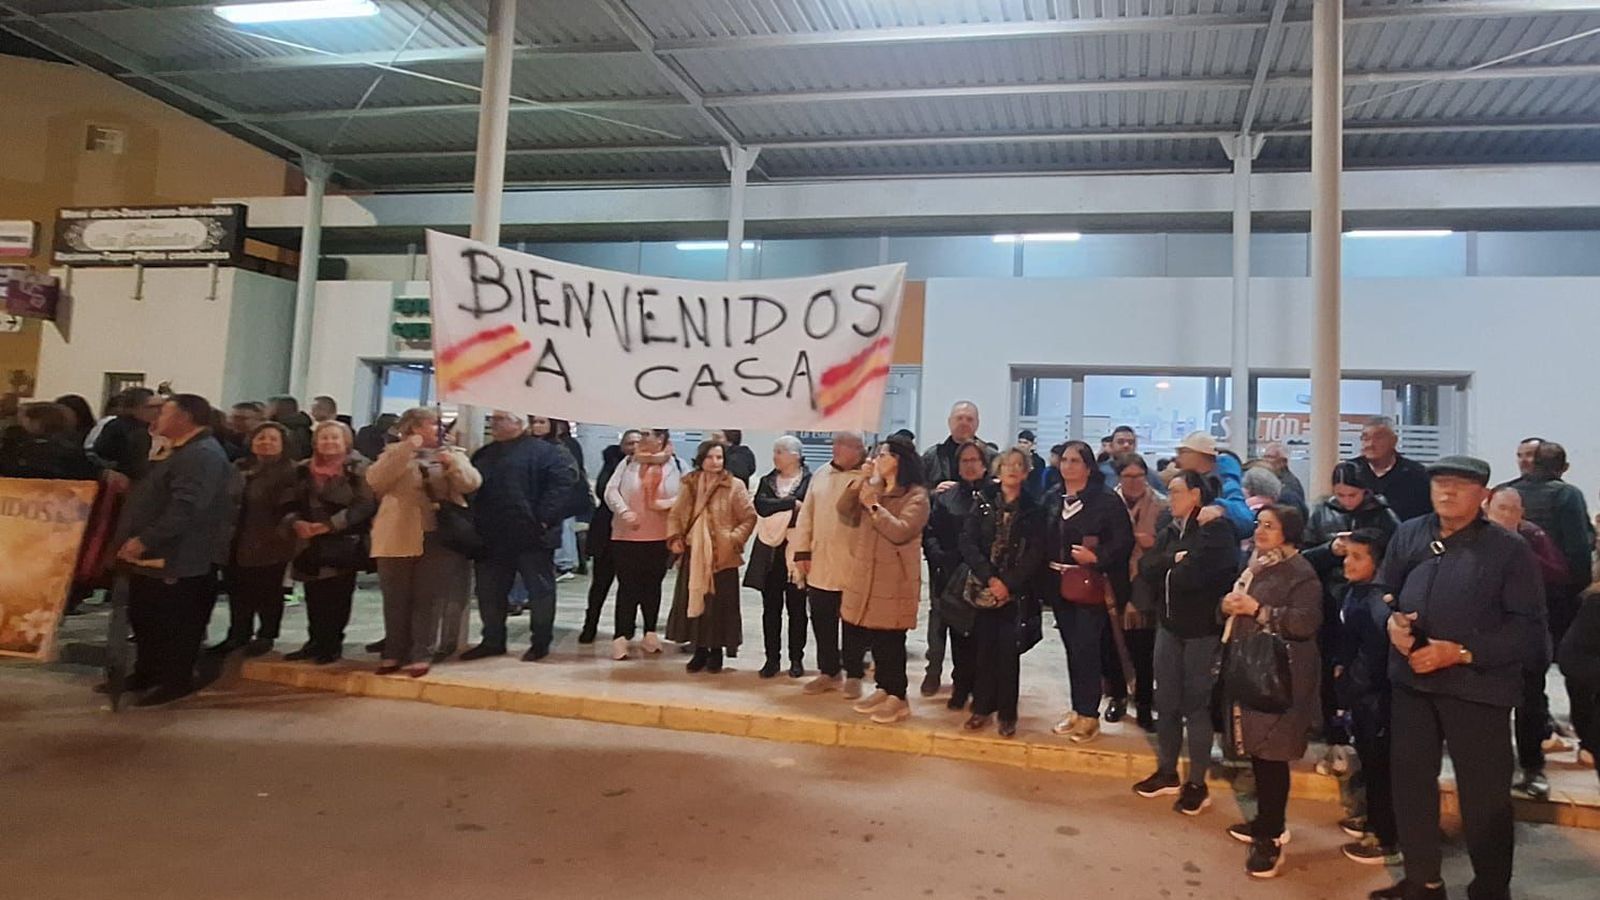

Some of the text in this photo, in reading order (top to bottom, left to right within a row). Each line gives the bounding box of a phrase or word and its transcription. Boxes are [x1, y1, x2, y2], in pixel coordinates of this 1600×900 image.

[457, 247, 885, 353] BIENVENIDOS
[525, 337, 818, 411] A CASA
[1207, 409, 1300, 442] Esción
